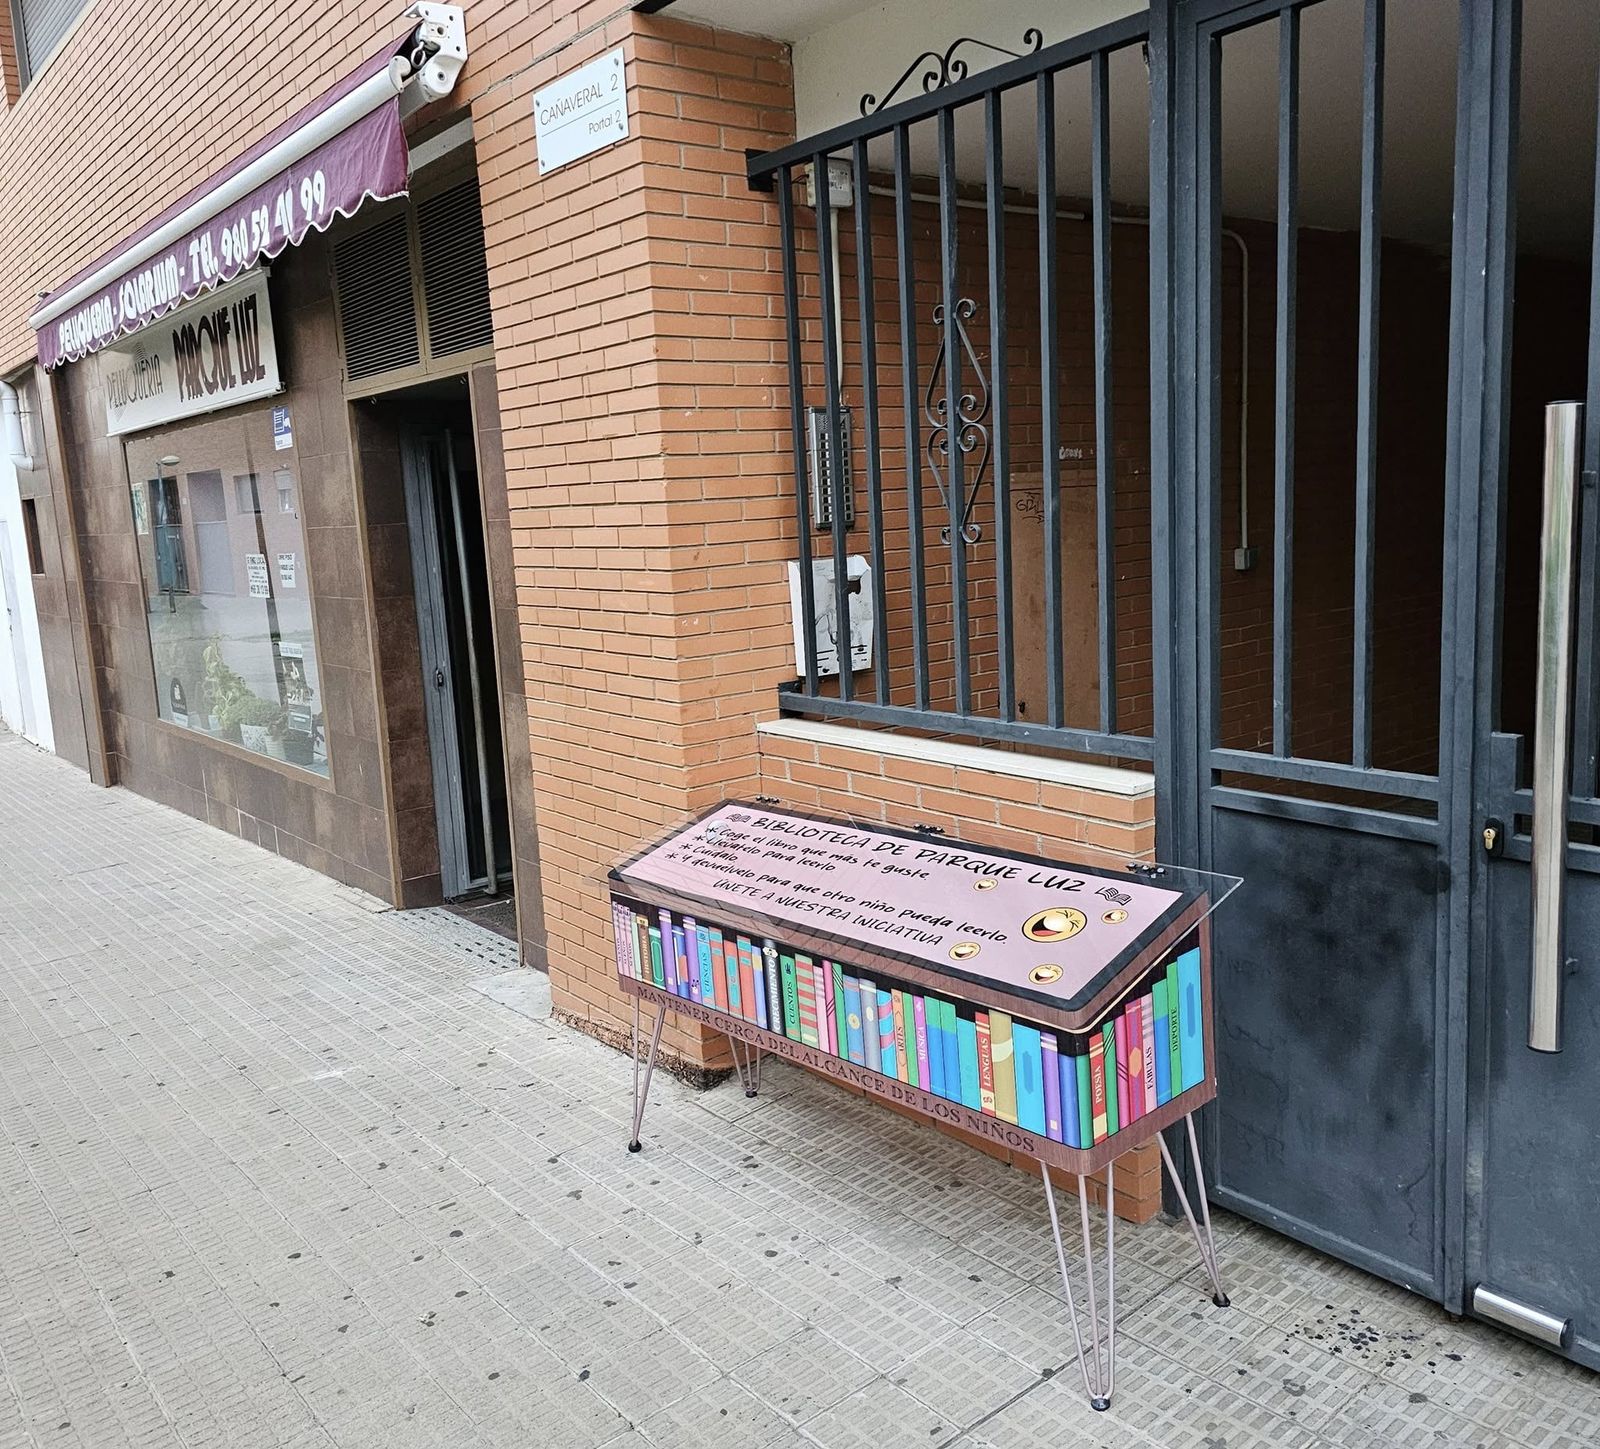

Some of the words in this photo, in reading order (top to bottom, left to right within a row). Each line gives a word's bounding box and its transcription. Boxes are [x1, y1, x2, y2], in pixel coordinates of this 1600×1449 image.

[540, 82, 603, 126] CAÑAVERAL
[610, 73, 618, 92] 2
[588, 113, 613, 135] Portal
[615, 109, 621, 123] 2
[189, 231, 218, 284] TEL.
[221, 218, 248, 266] 980
[251, 205, 270, 251] 52
[275, 187, 293, 236] 41
[301, 170, 325, 221] 99
[106, 354, 164, 409] PELUQUERIA
[172, 306, 236, 402] PARQUE
[232, 293, 266, 385] LUZ
[719, 828, 751, 841] Coge
[752, 836, 767, 844] el
[765, 838, 798, 851] libro
[801, 846, 828, 856] que
[863, 858, 881, 868] te
[881, 864, 930, 880] guste.
[751, 817, 871, 848] BIBLIOTECA
[872, 841, 909, 855] DE
[914, 848, 1022, 879] PARQUE
[1027, 871, 1086, 892] LUZ
[761, 849, 796, 862] para
[713, 879, 762, 897] ÚNETE
[760, 892, 775, 901] A
[775, 896, 851, 920] NUESTRA
[852, 915, 943, 945] INICIATIVA
[756, 873, 791, 887] para
[793, 881, 821, 894] que
[822, 890, 856, 903] otro
[859, 900, 895, 913] niño
[898, 909, 953, 927] pueda
[956, 922, 1007, 944] leerlo.
[641, 934, 650, 975] HISTORIA
[703, 951, 712, 993] CIENCIAS
[767, 958, 782, 1031] CRECIMIENTO
[786, 981, 796, 1025] CUENTOS
[896, 1026, 905, 1052] ARTES
[1171, 1008, 1179, 1052] DEPORTE
[637, 986, 711, 1024] MANTENER
[714, 1016, 765, 1045] CERCA
[768, 1037, 801, 1058] DEL
[802, 1054, 886, 1094] ALCANCE
[891, 1085, 917, 1106] DE
[922, 1097, 962, 1123] LOS
[967, 1114, 1036, 1152] NIÑOS
[980, 1036, 991, 1087] LENGUAS
